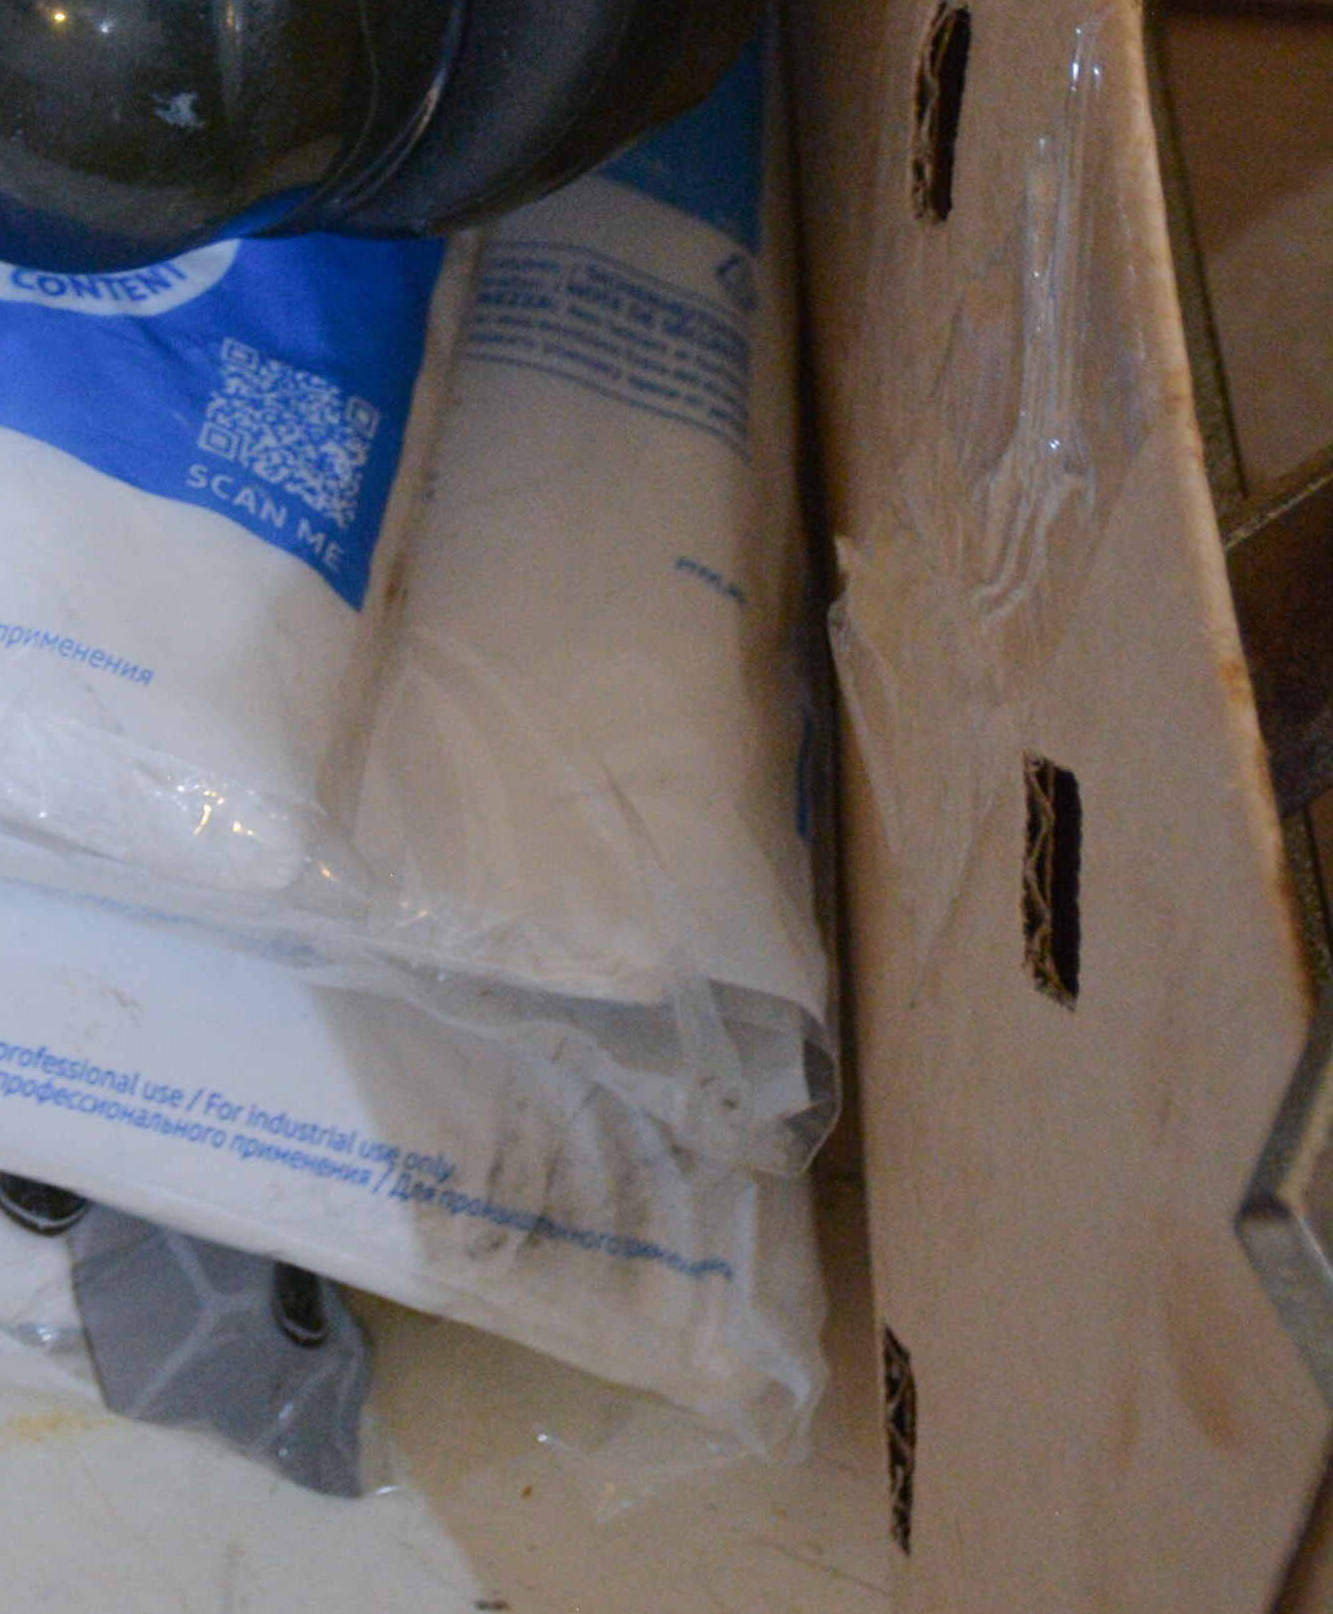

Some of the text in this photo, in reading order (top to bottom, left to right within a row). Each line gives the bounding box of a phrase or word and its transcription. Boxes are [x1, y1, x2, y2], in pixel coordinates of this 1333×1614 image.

[10, 260, 189, 302] CONTENT
[185, 463, 345, 572] SCAN ME
[142, 1081, 185, 1108] use
[203, 1092, 245, 1122] For
[246, 1103, 358, 1155] industrial
[358, 1138, 400, 1163] use
